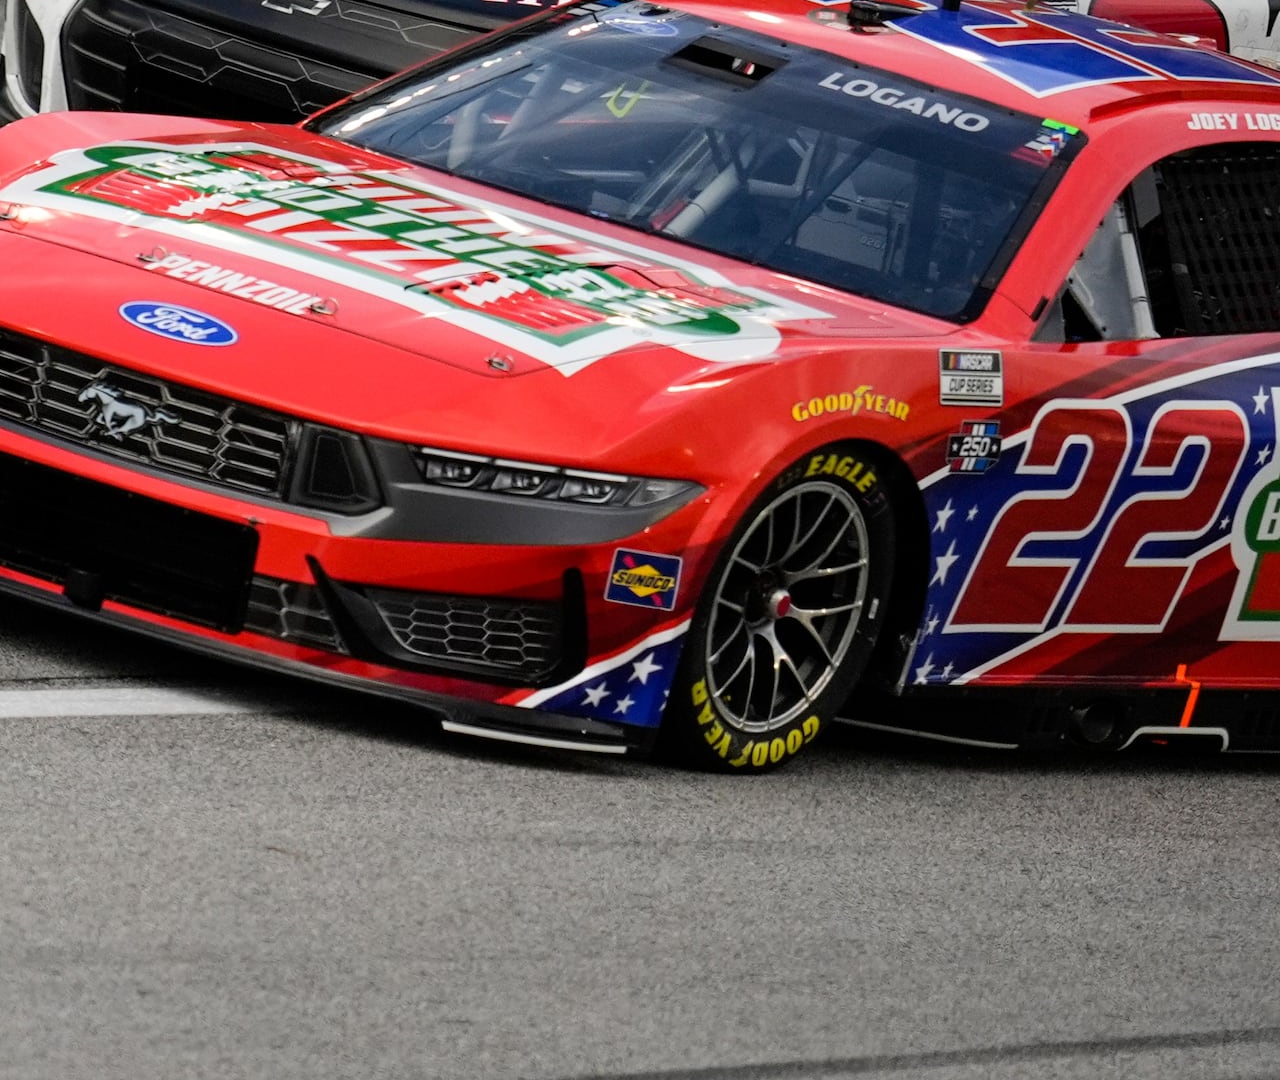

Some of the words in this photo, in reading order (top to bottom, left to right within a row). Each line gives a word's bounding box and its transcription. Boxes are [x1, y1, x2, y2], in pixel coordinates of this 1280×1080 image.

[818, 72, 990, 133] LOGANO
[1187, 113, 1238, 130] JOEY
[145, 251, 322, 315] PENNZOIL
[137, 307, 218, 340] Ford
[961, 353, 994, 371] NASCAR
[948, 377, 965, 393] CUP
[966, 378, 994, 393] SERIES
[792, 385, 909, 422] GOODYEAR
[959, 436, 991, 457] 250
[803, 453, 878, 494] EAGLE
[942, 399, 1250, 634] 22
[615, 571, 672, 590] SUNOCO
